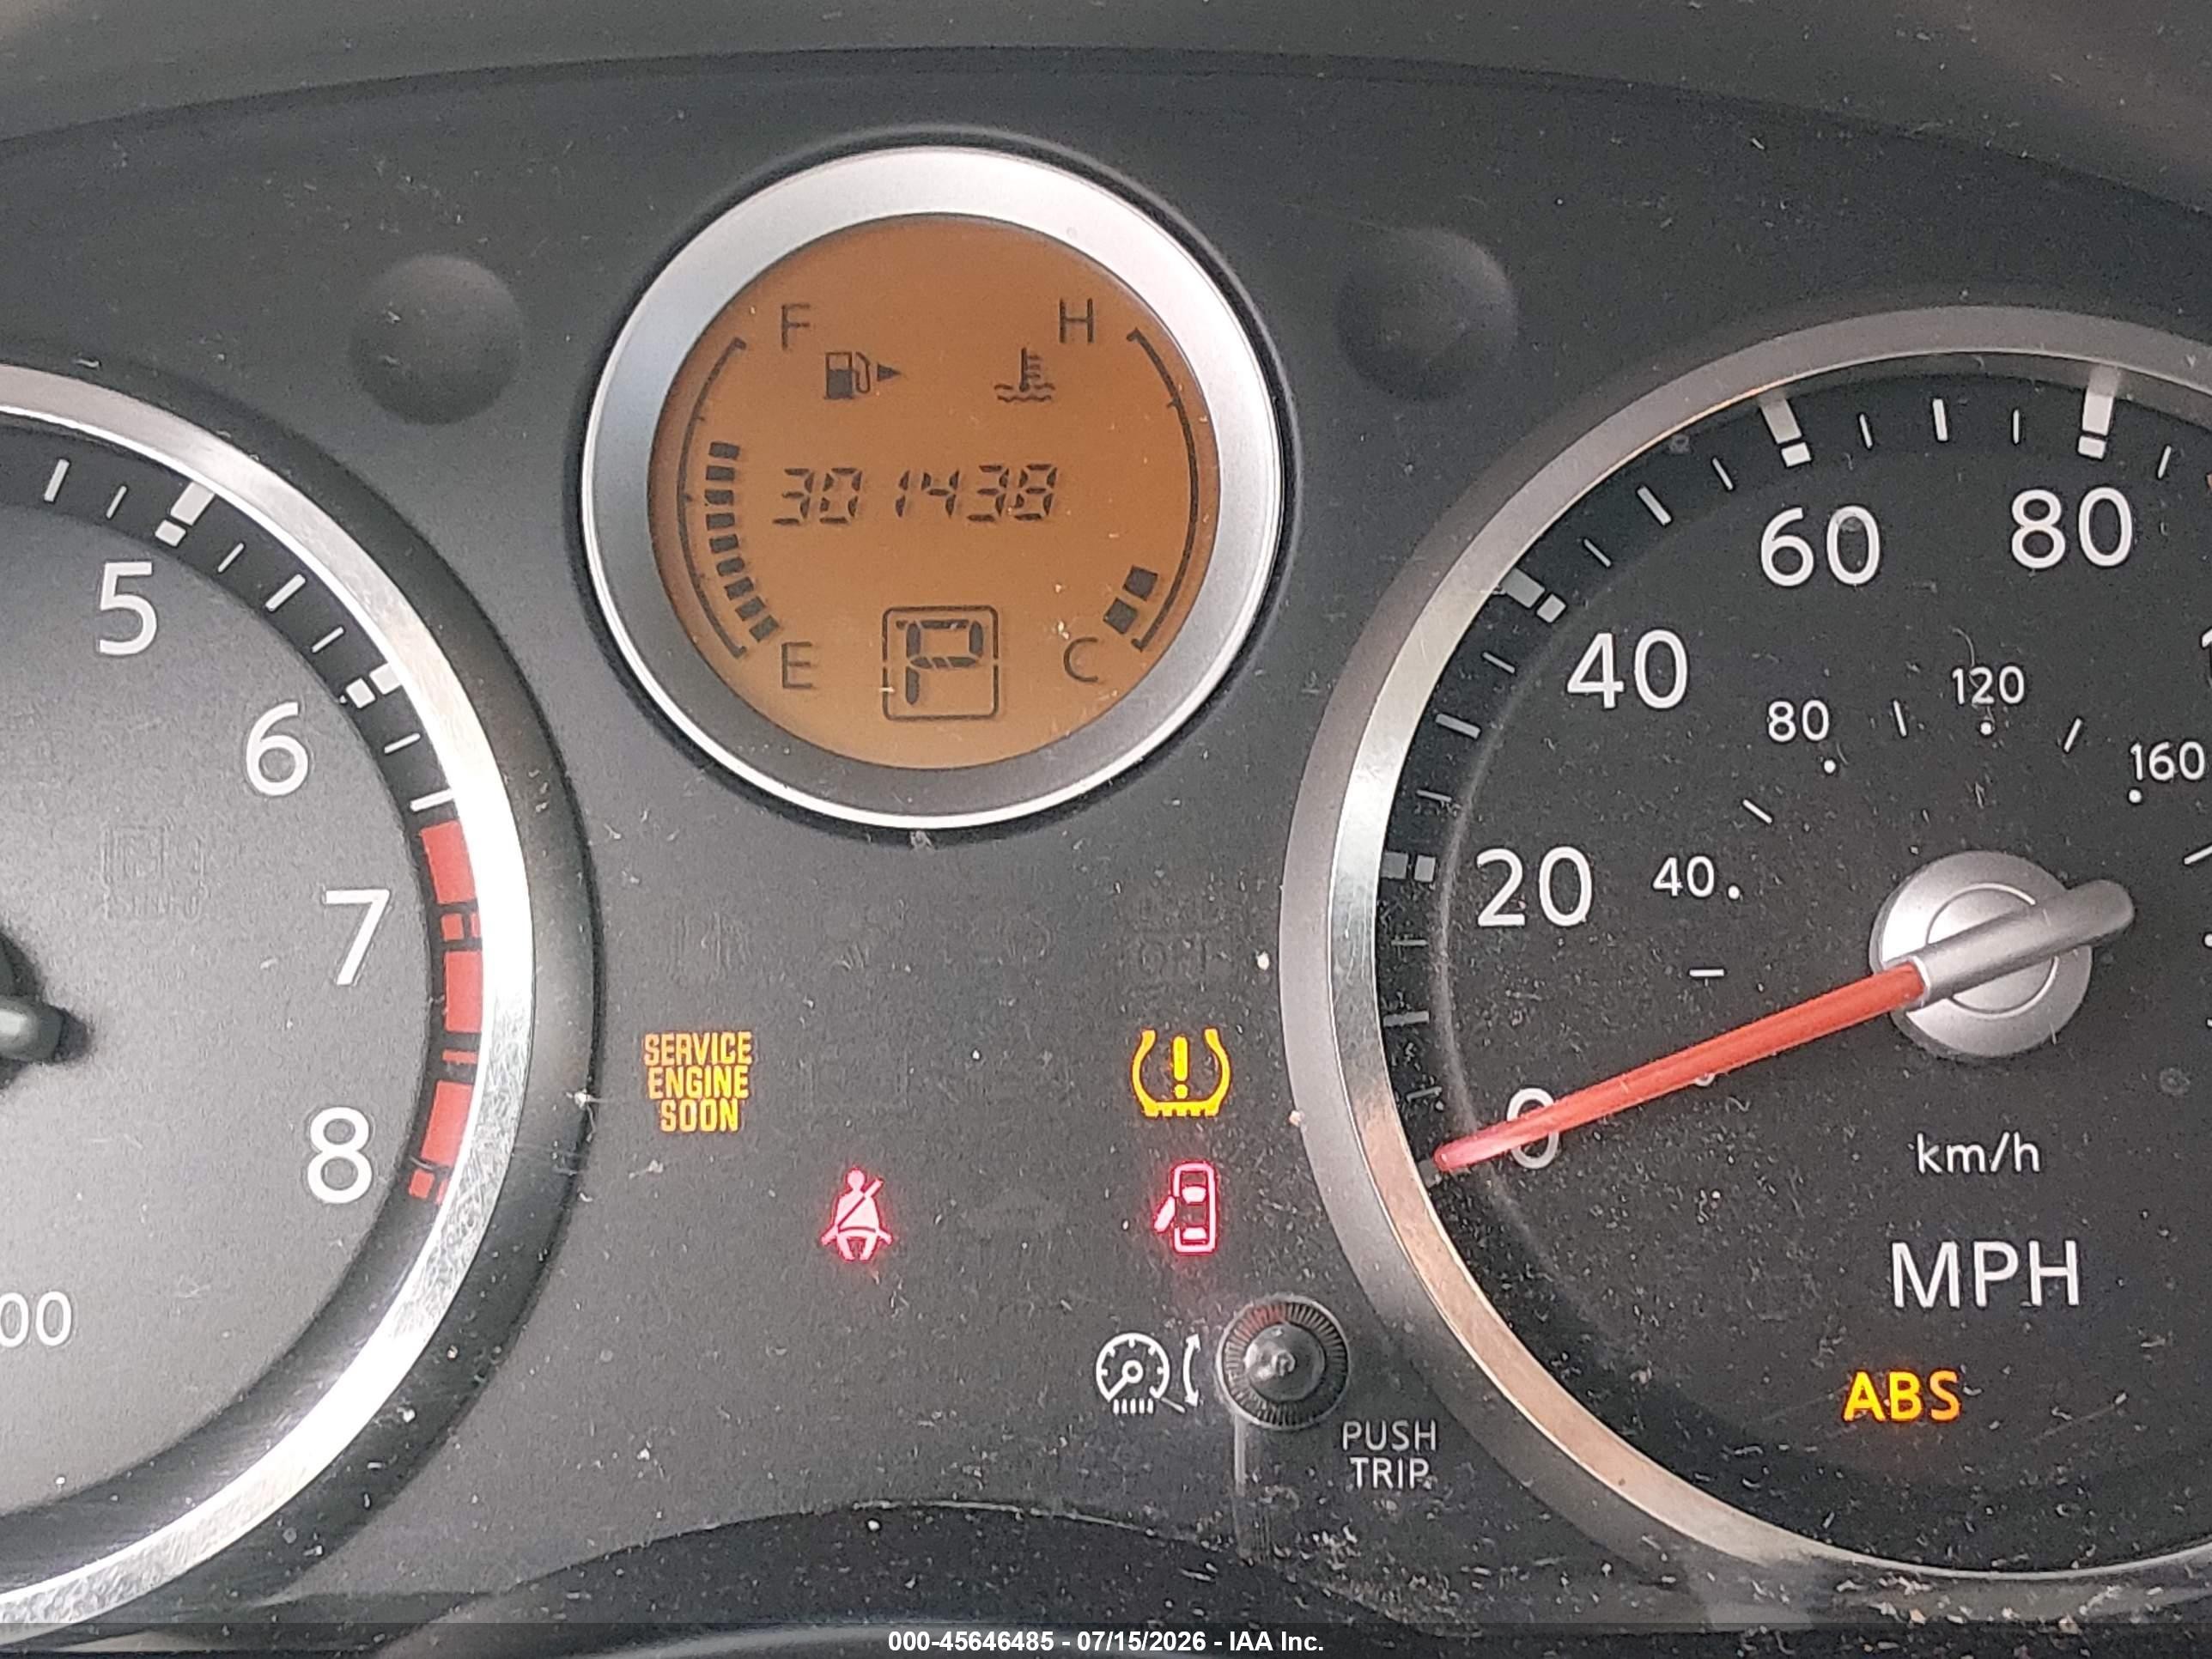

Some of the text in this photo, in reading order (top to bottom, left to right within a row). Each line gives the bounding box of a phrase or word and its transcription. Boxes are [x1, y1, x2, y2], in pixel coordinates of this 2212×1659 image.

[781, 303, 811, 351] F
[1059, 297, 1094, 344] H
[773, 464, 1058, 526] 301438
[1760, 506, 1881, 586] 60
[2011, 487, 2133, 568] 80
[99, 562, 157, 655] 5
[781, 641, 815, 690] E
[896, 618, 985, 706] P
[1063, 636, 1099, 684] C
[1567, 629, 1688, 709] 40
[1952, 665, 2025, 705] 120
[1768, 700, 1830, 742] 80
[246, 702, 308, 796] 6
[2130, 741, 2205, 781] 160
[1476, 846, 1592, 927] 20
[1653, 856, 1715, 897] 40
[325, 889, 390, 986] 7
[643, 1030, 753, 1066] SERVICE
[647, 1065, 750, 1099] ENGINE
[659, 1098, 739, 1133] SOON
[1506, 1087, 1561, 1170] 0
[307, 1107, 373, 1204] 8
[1916, 1132, 2040, 1174] km/h
[1892, 1240, 2081, 1308] MPH
[1842, 1369, 1963, 1422] ABS
[1342, 1419, 1437, 1452] PUSH
[1350, 1456, 1431, 1490] TRIP
